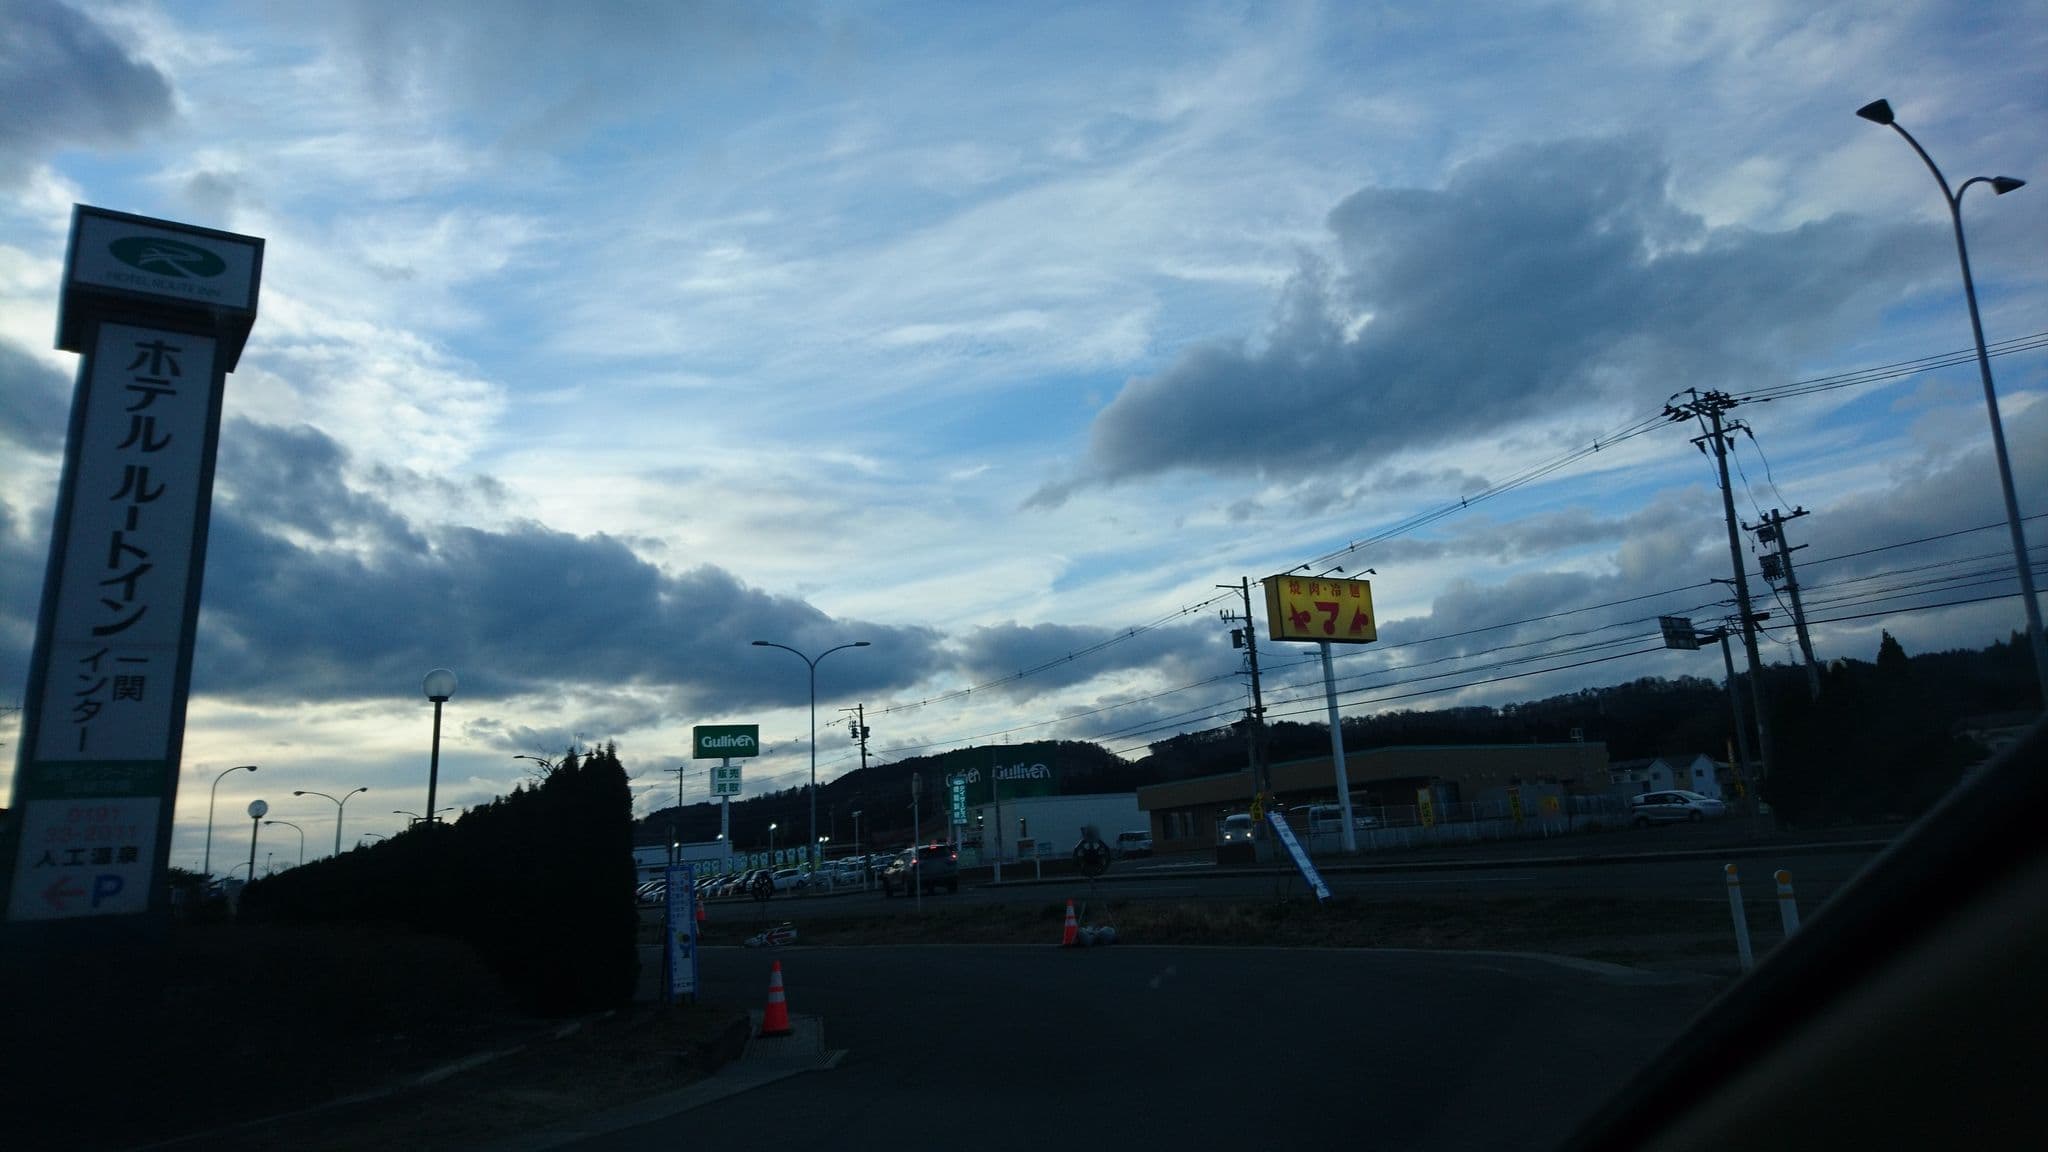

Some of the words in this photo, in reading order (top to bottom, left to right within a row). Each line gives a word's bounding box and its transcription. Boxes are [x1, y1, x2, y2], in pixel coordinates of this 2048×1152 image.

[93, 340, 182, 636] ホテルルートイン
[72, 648, 109, 753] インター
[113, 657, 149, 703] 一関
[701, 734, 755, 748] Gulliver
[93, 874, 123, 906] P
